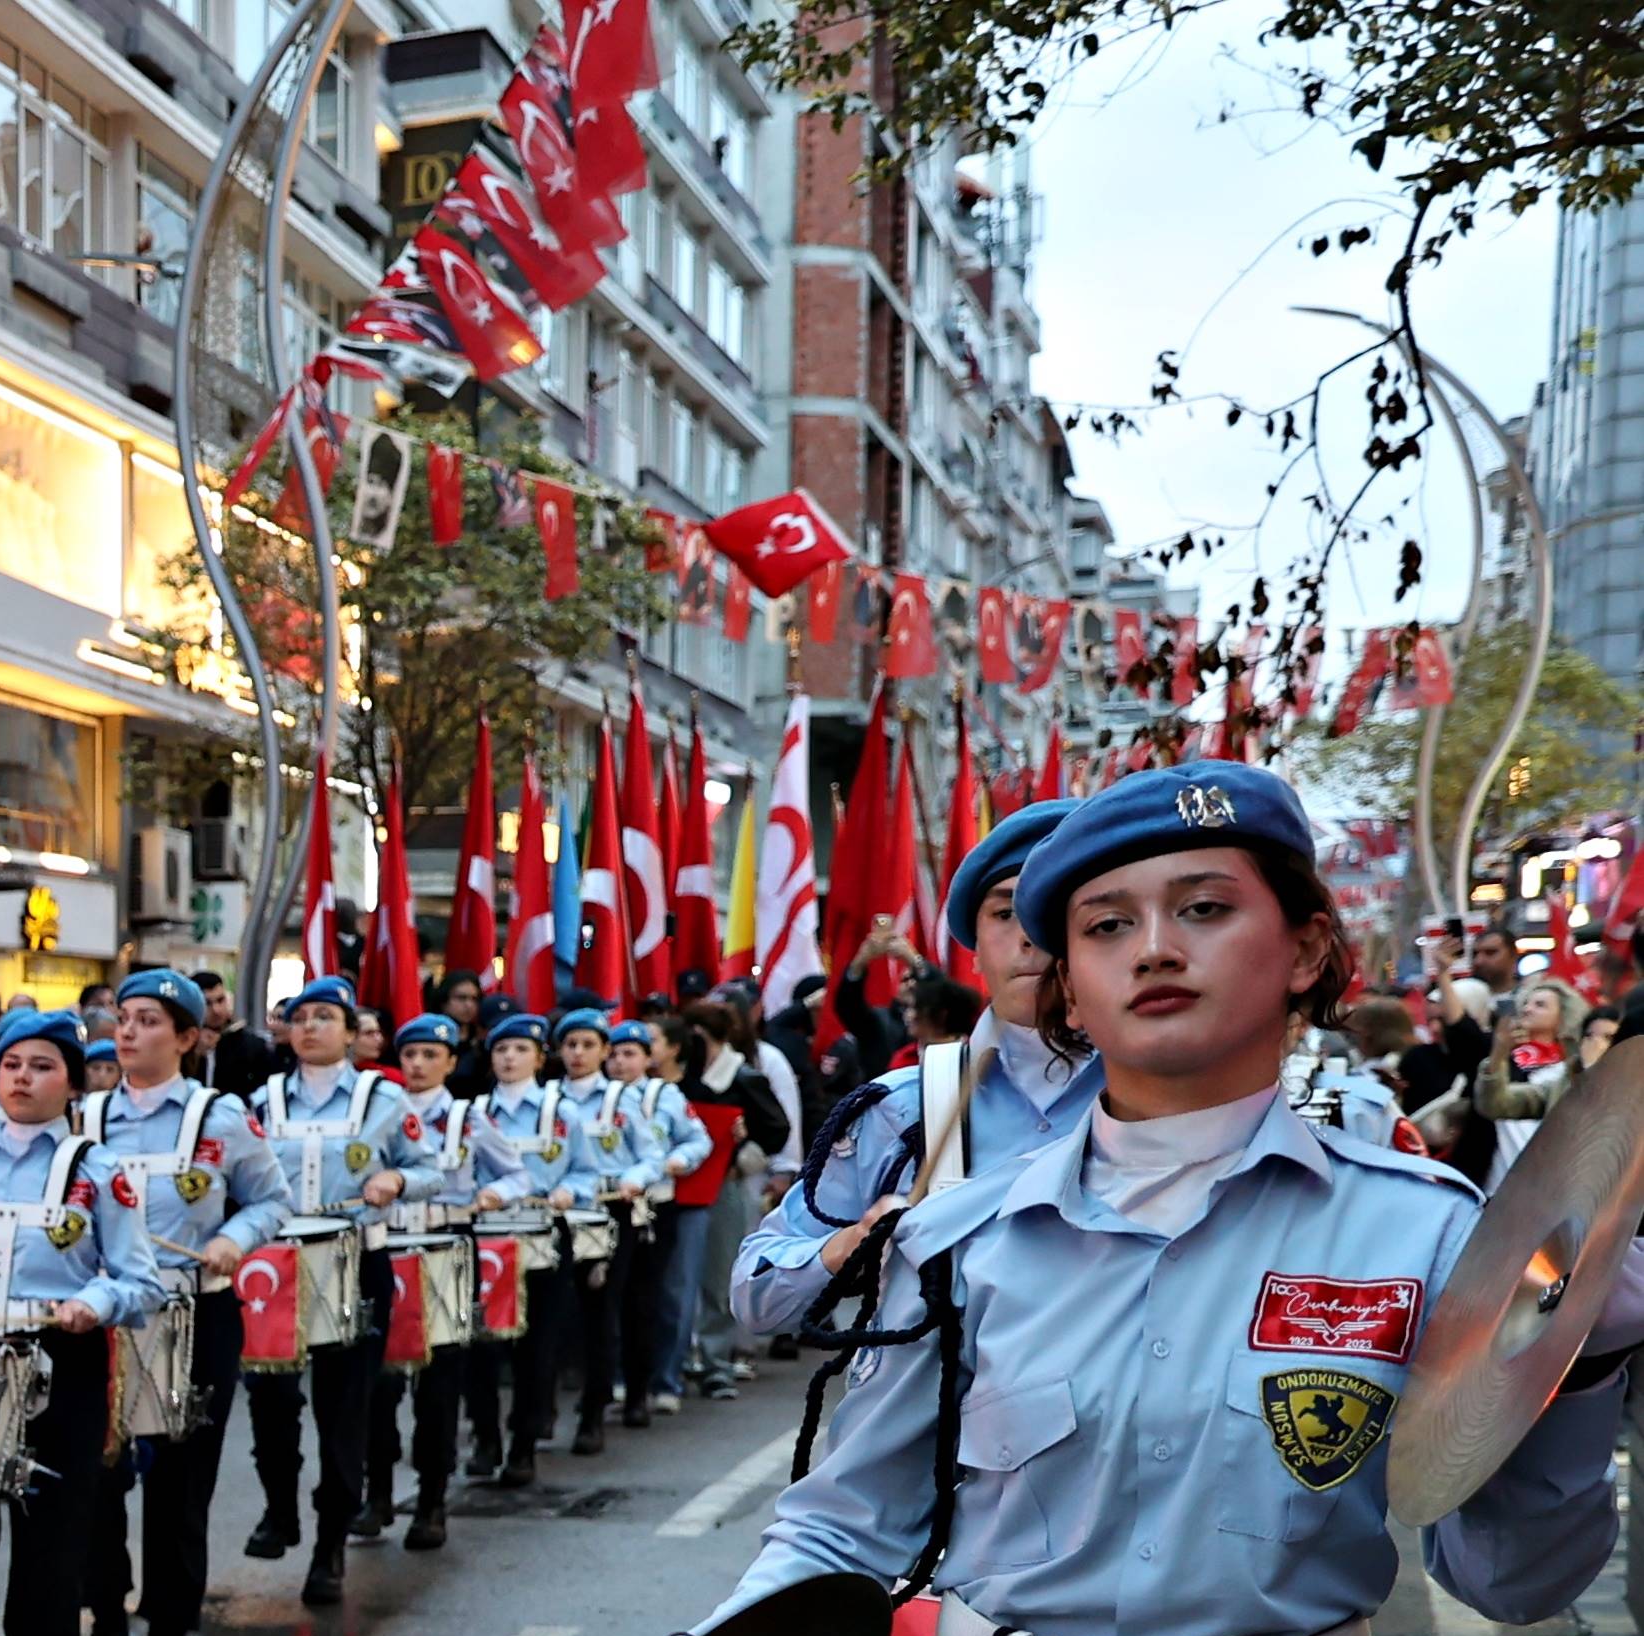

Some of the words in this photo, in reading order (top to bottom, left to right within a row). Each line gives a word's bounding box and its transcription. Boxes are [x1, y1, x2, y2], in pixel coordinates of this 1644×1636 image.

[1344, 1338, 1372, 1349] 2023
[1277, 1373, 1386, 1405] ONDOKUZMAYIS
[1271, 1401, 1310, 1467] SAMSUN
